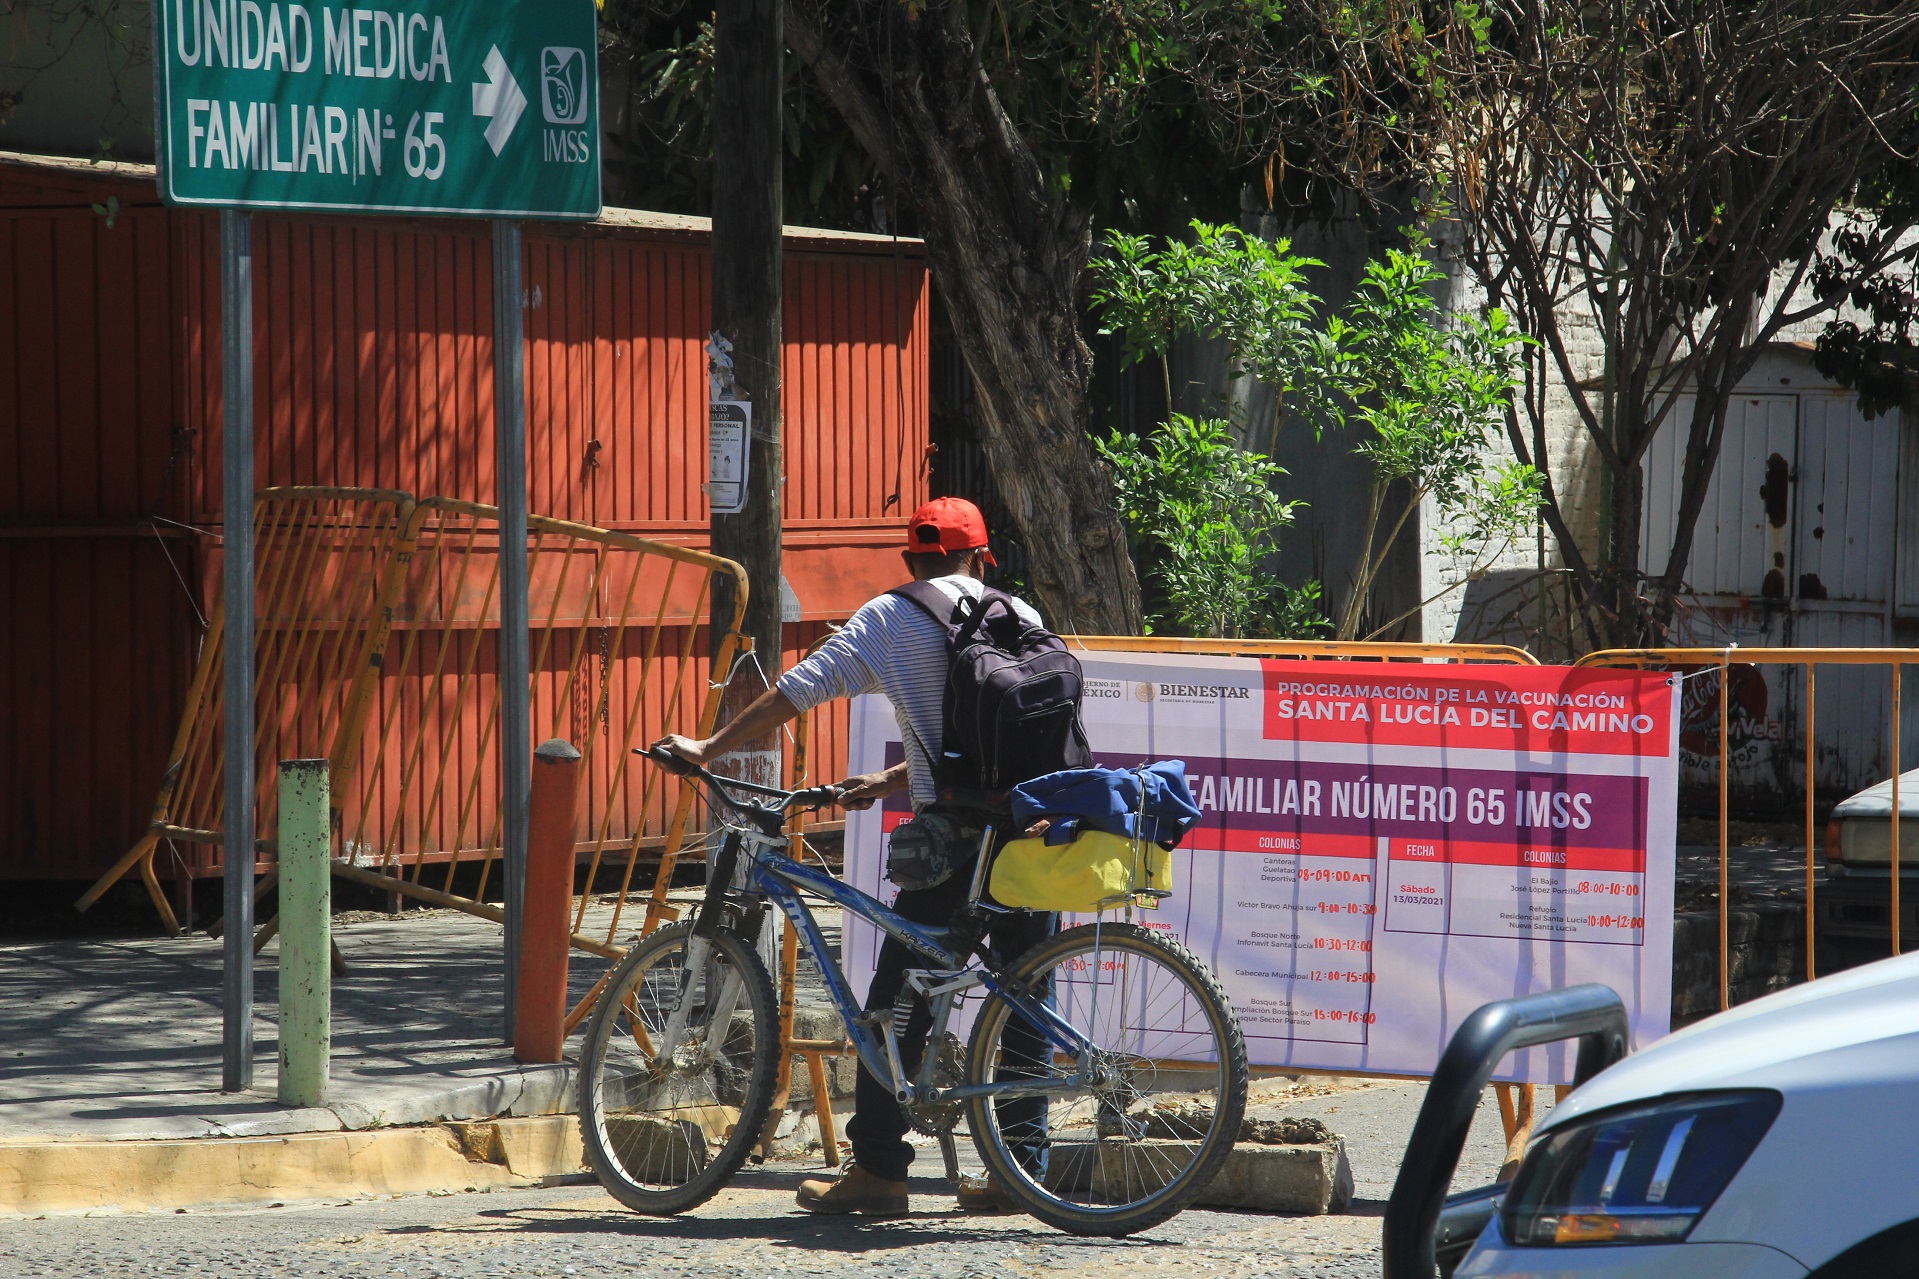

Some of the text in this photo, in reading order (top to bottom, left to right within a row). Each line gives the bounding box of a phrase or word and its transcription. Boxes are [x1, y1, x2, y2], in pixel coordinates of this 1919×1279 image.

[177, 0, 452, 83] UNIDAD MEDICA
[187, 98, 348, 175] FAMILIAR
[404, 110, 446, 180] 65
[543, 128, 589, 163] IMSS
[1083, 687, 1121, 698] ÉXICO
[1160, 684, 1250, 699] BIENESTAR
[1278, 681, 1625, 709] PROGRAMACIÓN DE LA VACUNACIÓN
[1278, 700, 1654, 734] SANTA LUCÍA DEL CAMINO
[1184, 774, 1592, 830] FAMILIAR NÚMERO 65 IMSS
[1258, 836, 1301, 850] COLONIAS
[1406, 844, 1435, 857] FECHA
[1263, 857, 1296, 865] Canteras
[1524, 851, 1567, 864] COLONIAS
[1262, 866, 1296, 874] Guelatao
[1261, 874, 1297, 883] Deportiva
[1400, 884, 1436, 894] Sábado
[1510, 885, 1580, 896] José López Portillo
[1393, 895, 1444, 906] 13/03/2021
[1282, 903, 1304, 912] Ahuja
[1529, 905, 1557, 915] Refugio
[1500, 912, 1542, 922] Residencial
[1543, 915, 1564, 923] Santa
[1138, 920, 1171, 930] Viernes
[1509, 922, 1532, 930] Nueva
[1533, 923, 1554, 931] Santa
[1251, 931, 1278, 940] Bosque
[899, 928, 947, 960] KAIZER
[1237, 939, 1269, 947] Infonavit
[1235, 969, 1309, 981] Cabecera Municipal
[1310, 970, 1377, 983] 12:00-15:00
[1250, 998, 1277, 1007] Bosque
[1234, 1005, 1270, 1015] mpliación
[1272, 1008, 1299, 1017] Bosque
[1314, 1009, 1376, 1024] 15:00-16:00
[1259, 1016, 1283, 1024] Sector
